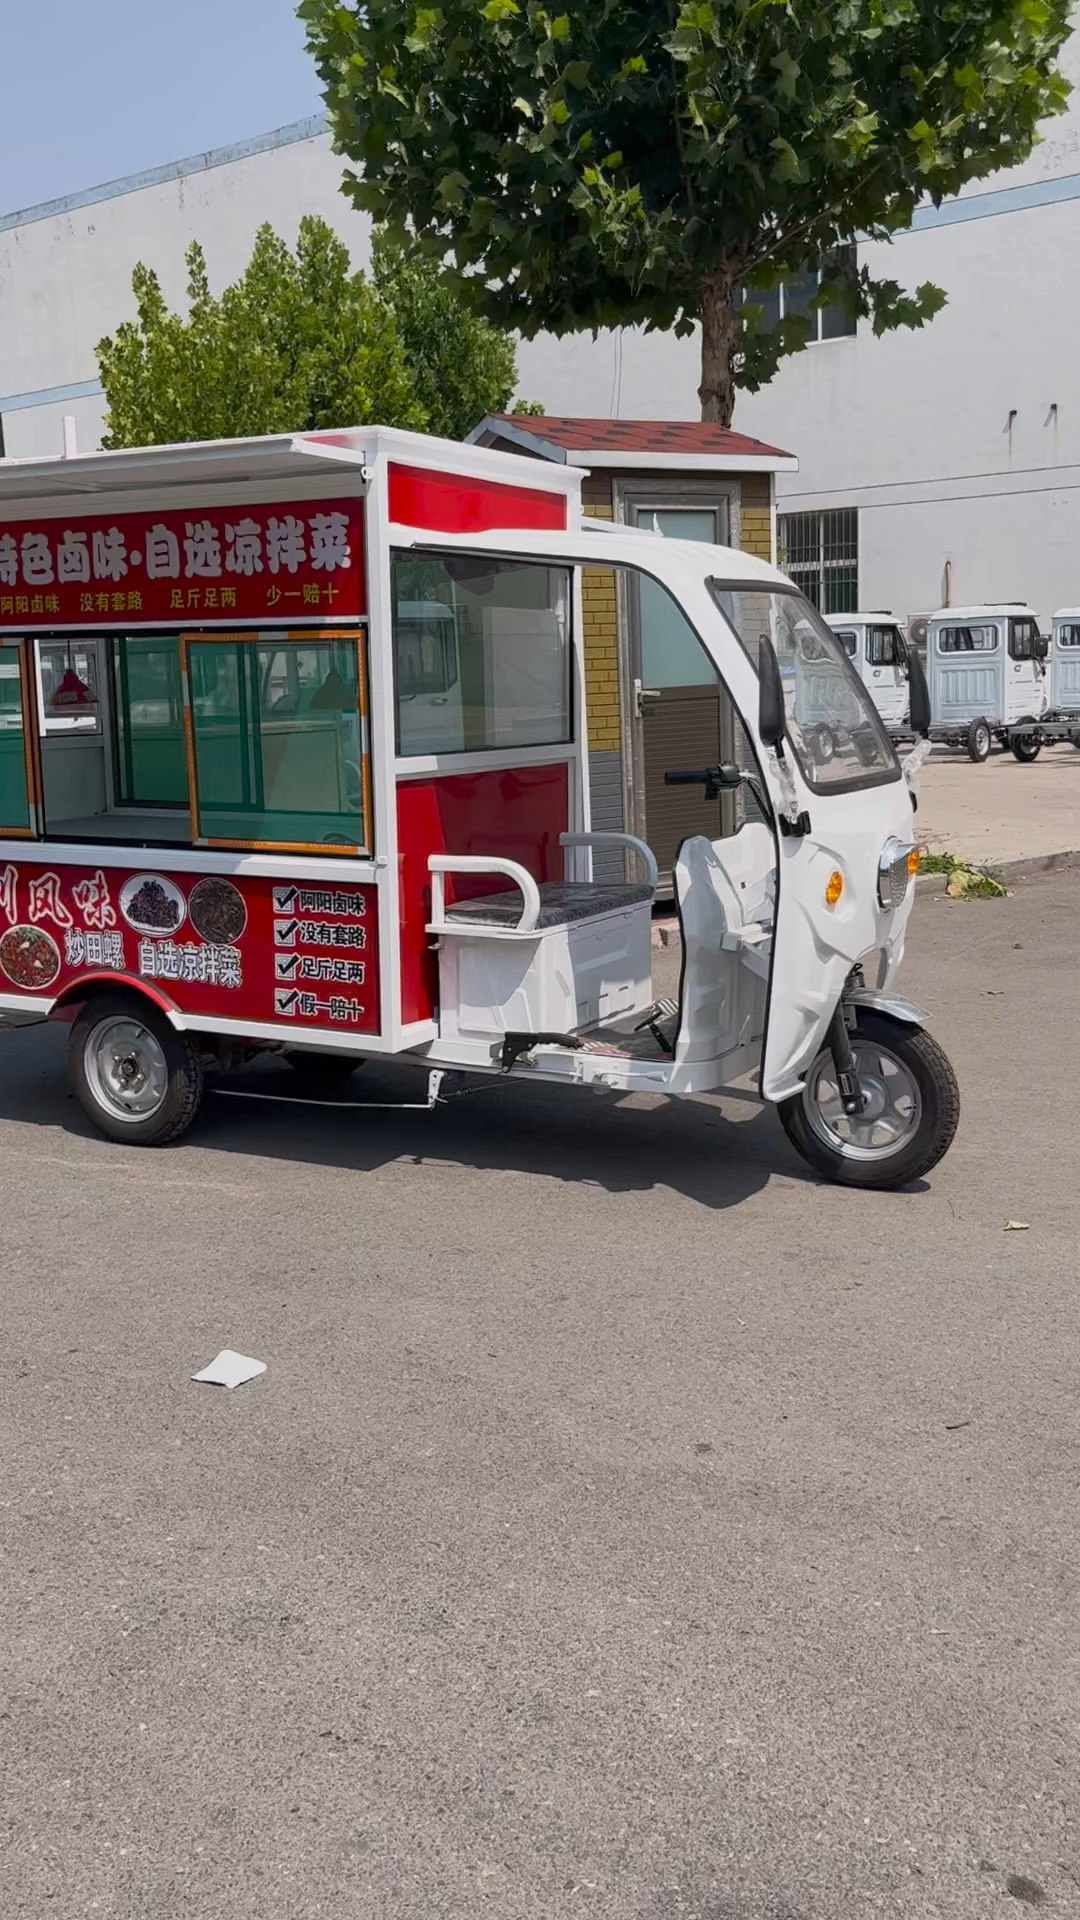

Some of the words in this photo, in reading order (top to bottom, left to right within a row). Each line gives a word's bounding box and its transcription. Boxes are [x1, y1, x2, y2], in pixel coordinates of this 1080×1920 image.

[80, 590, 143, 612] 没有套路
[170, 586, 237, 609] 足斤足两
[266, 582, 340, 606] 少一赔十
[299, 889, 366, 916] 阿阳卤味
[65, 928, 125, 969] 炒田螺
[300, 921, 366, 949] 没有套路
[139, 938, 242, 988] 自选凉拌菜
[300, 955, 365, 984] 足斤足两
